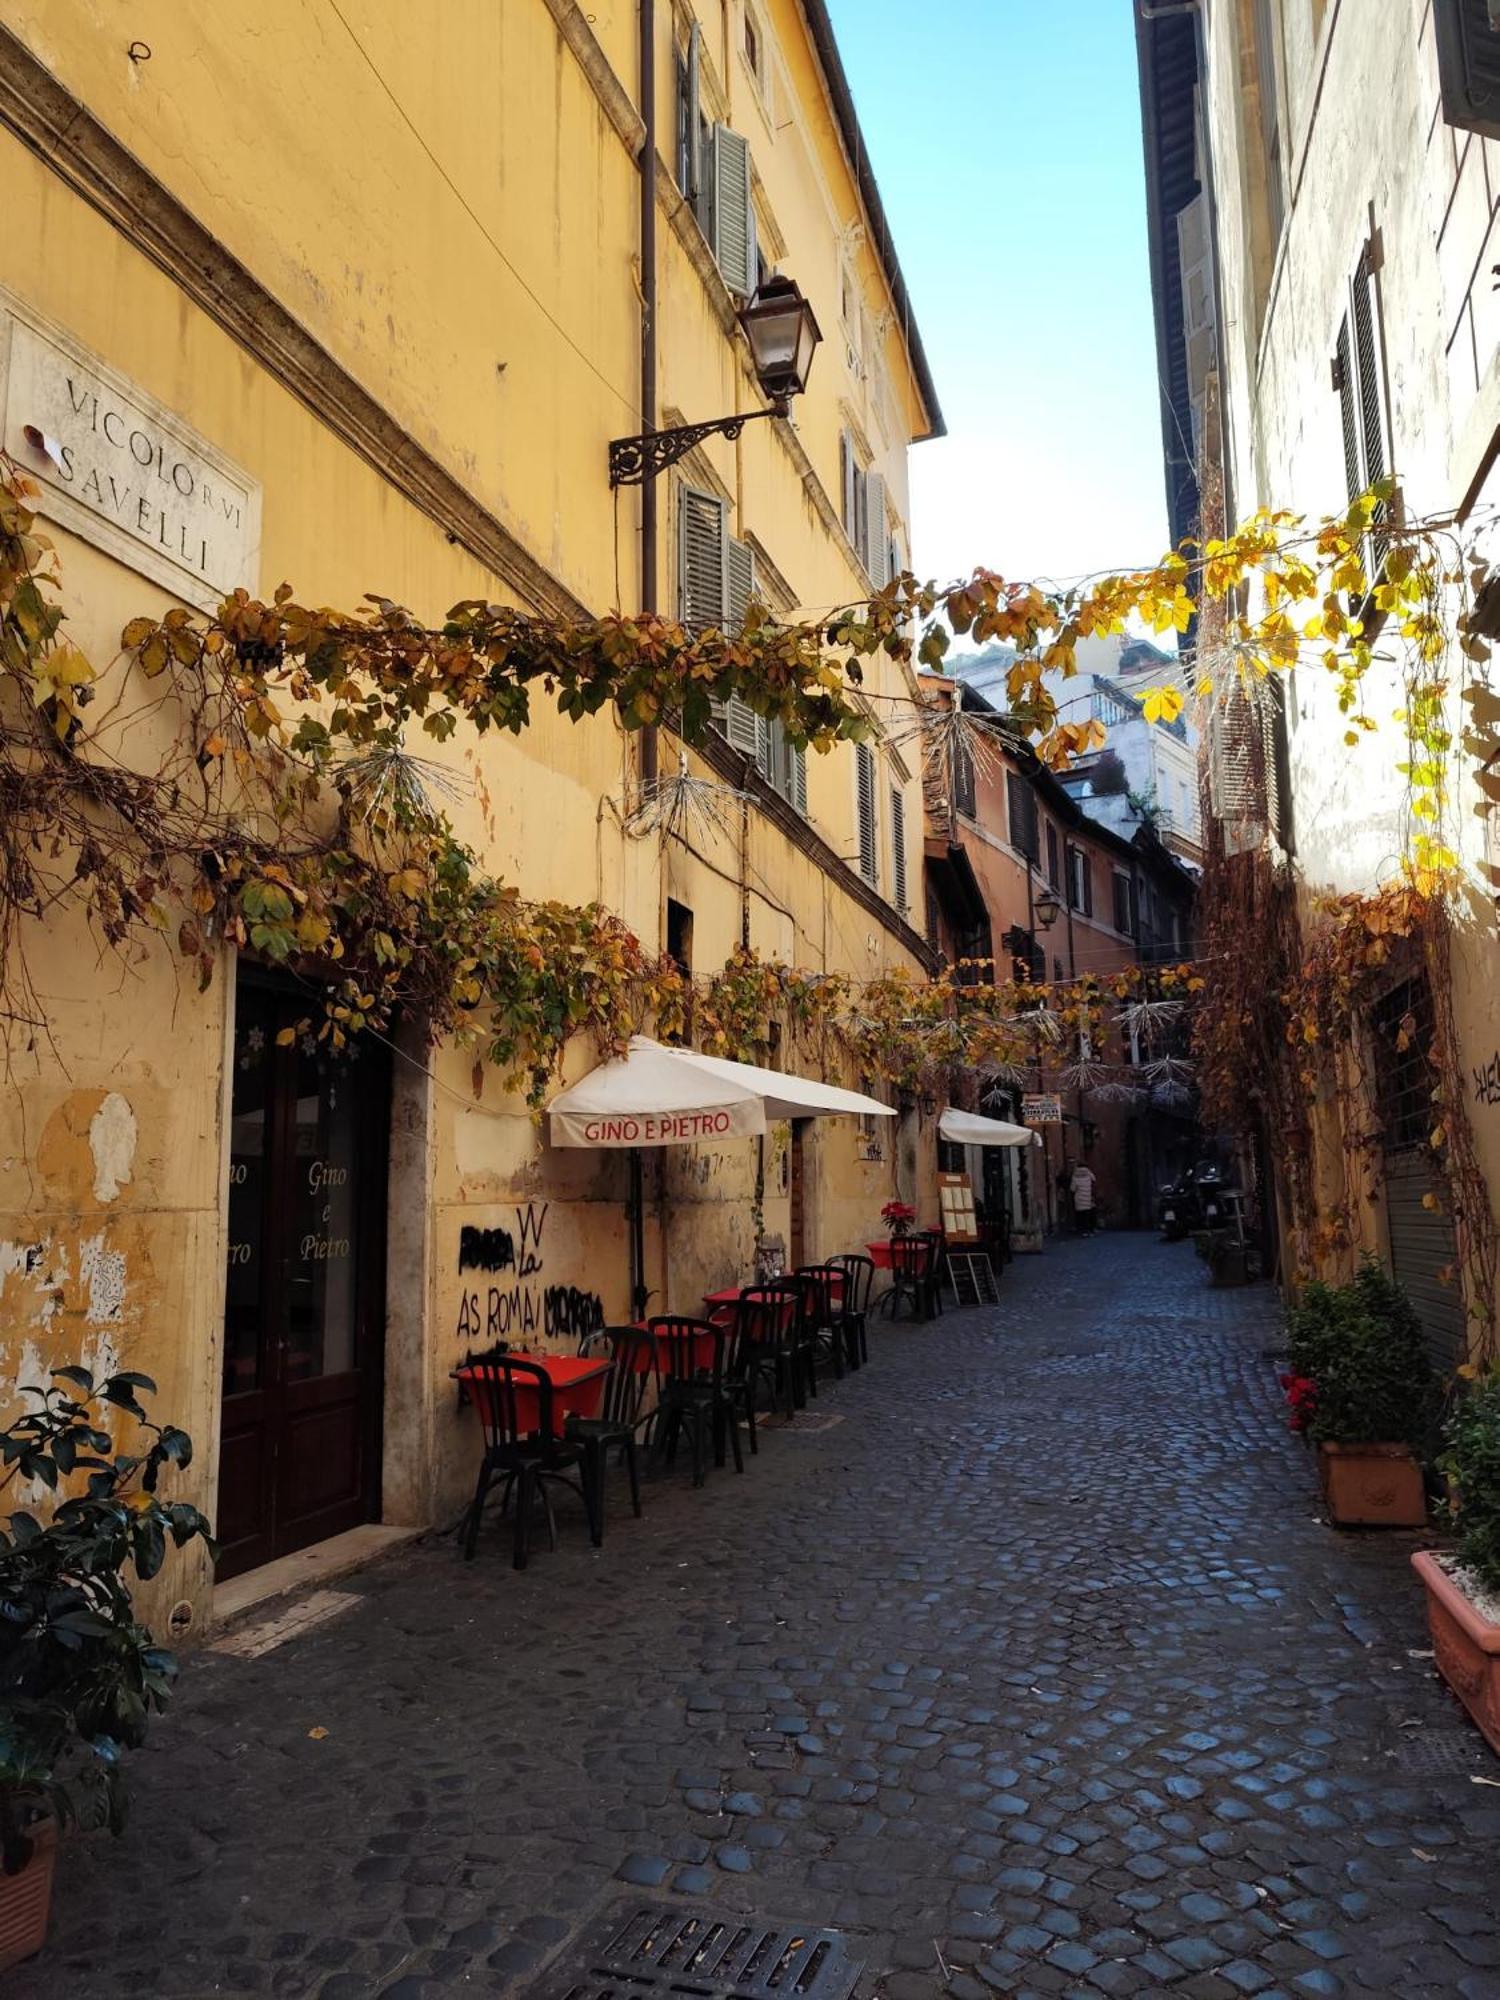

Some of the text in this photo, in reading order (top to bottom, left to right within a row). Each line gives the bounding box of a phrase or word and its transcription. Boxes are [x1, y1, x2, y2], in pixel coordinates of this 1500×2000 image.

[66, 378, 195, 496] VICOLO
[57, 446, 206, 570] SAVELLI
[584, 1112, 730, 1141] GINO E PIETRO
[308, 1161, 347, 1195] Gino
[322, 1203, 332, 1222] e
[300, 1233, 350, 1261] Pietro
[456, 1287, 481, 1337] AS
